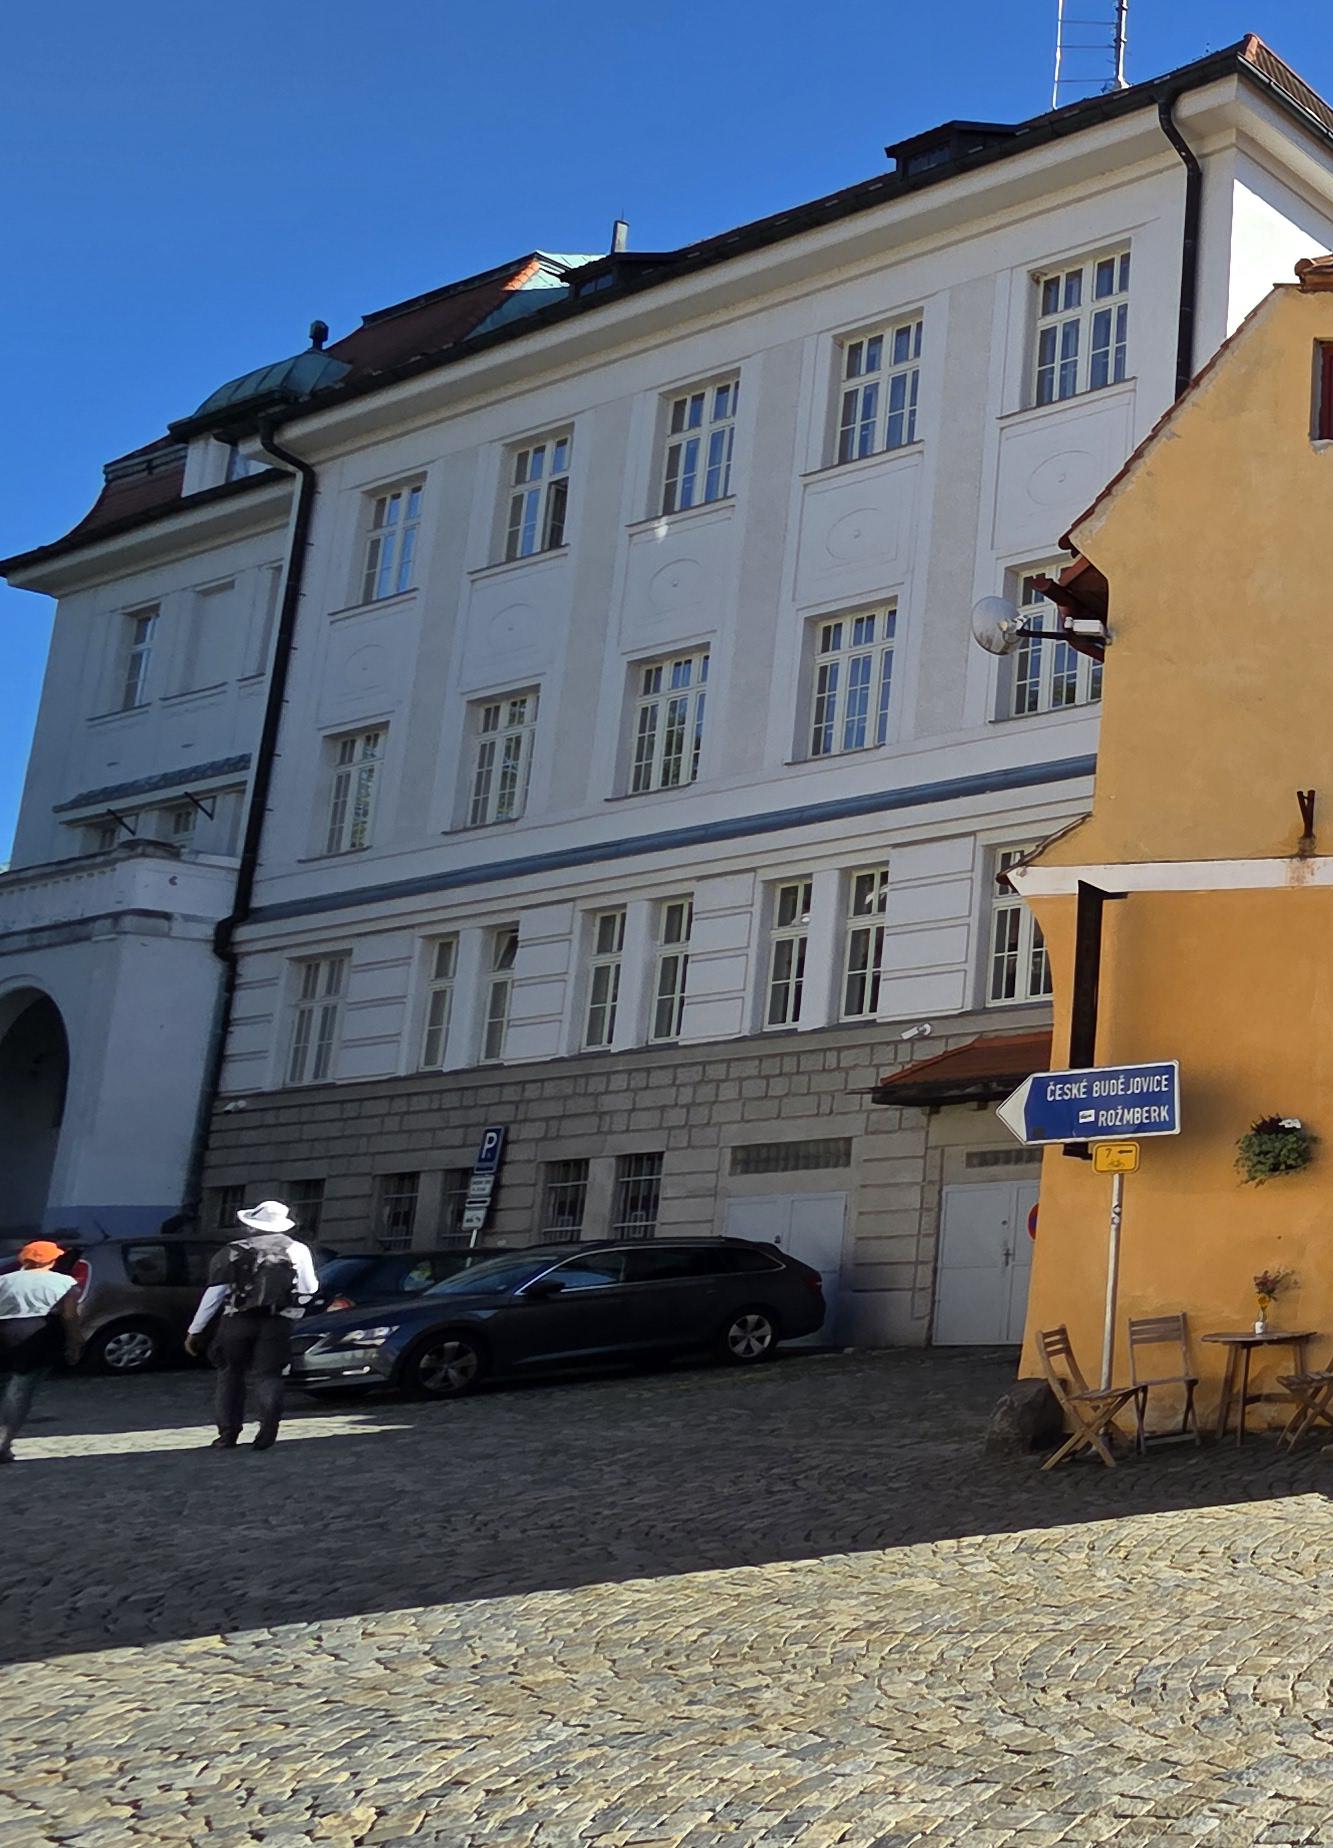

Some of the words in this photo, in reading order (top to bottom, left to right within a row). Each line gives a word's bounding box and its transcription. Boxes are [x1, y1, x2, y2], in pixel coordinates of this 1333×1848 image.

[1046, 1079, 1088, 1102] ČESKÉ
[1092, 1074, 1170, 1098] BUDĚJOVICE
[1098, 1105, 1170, 1127] ROŽMBERK
[481, 1131, 498, 1159] P
